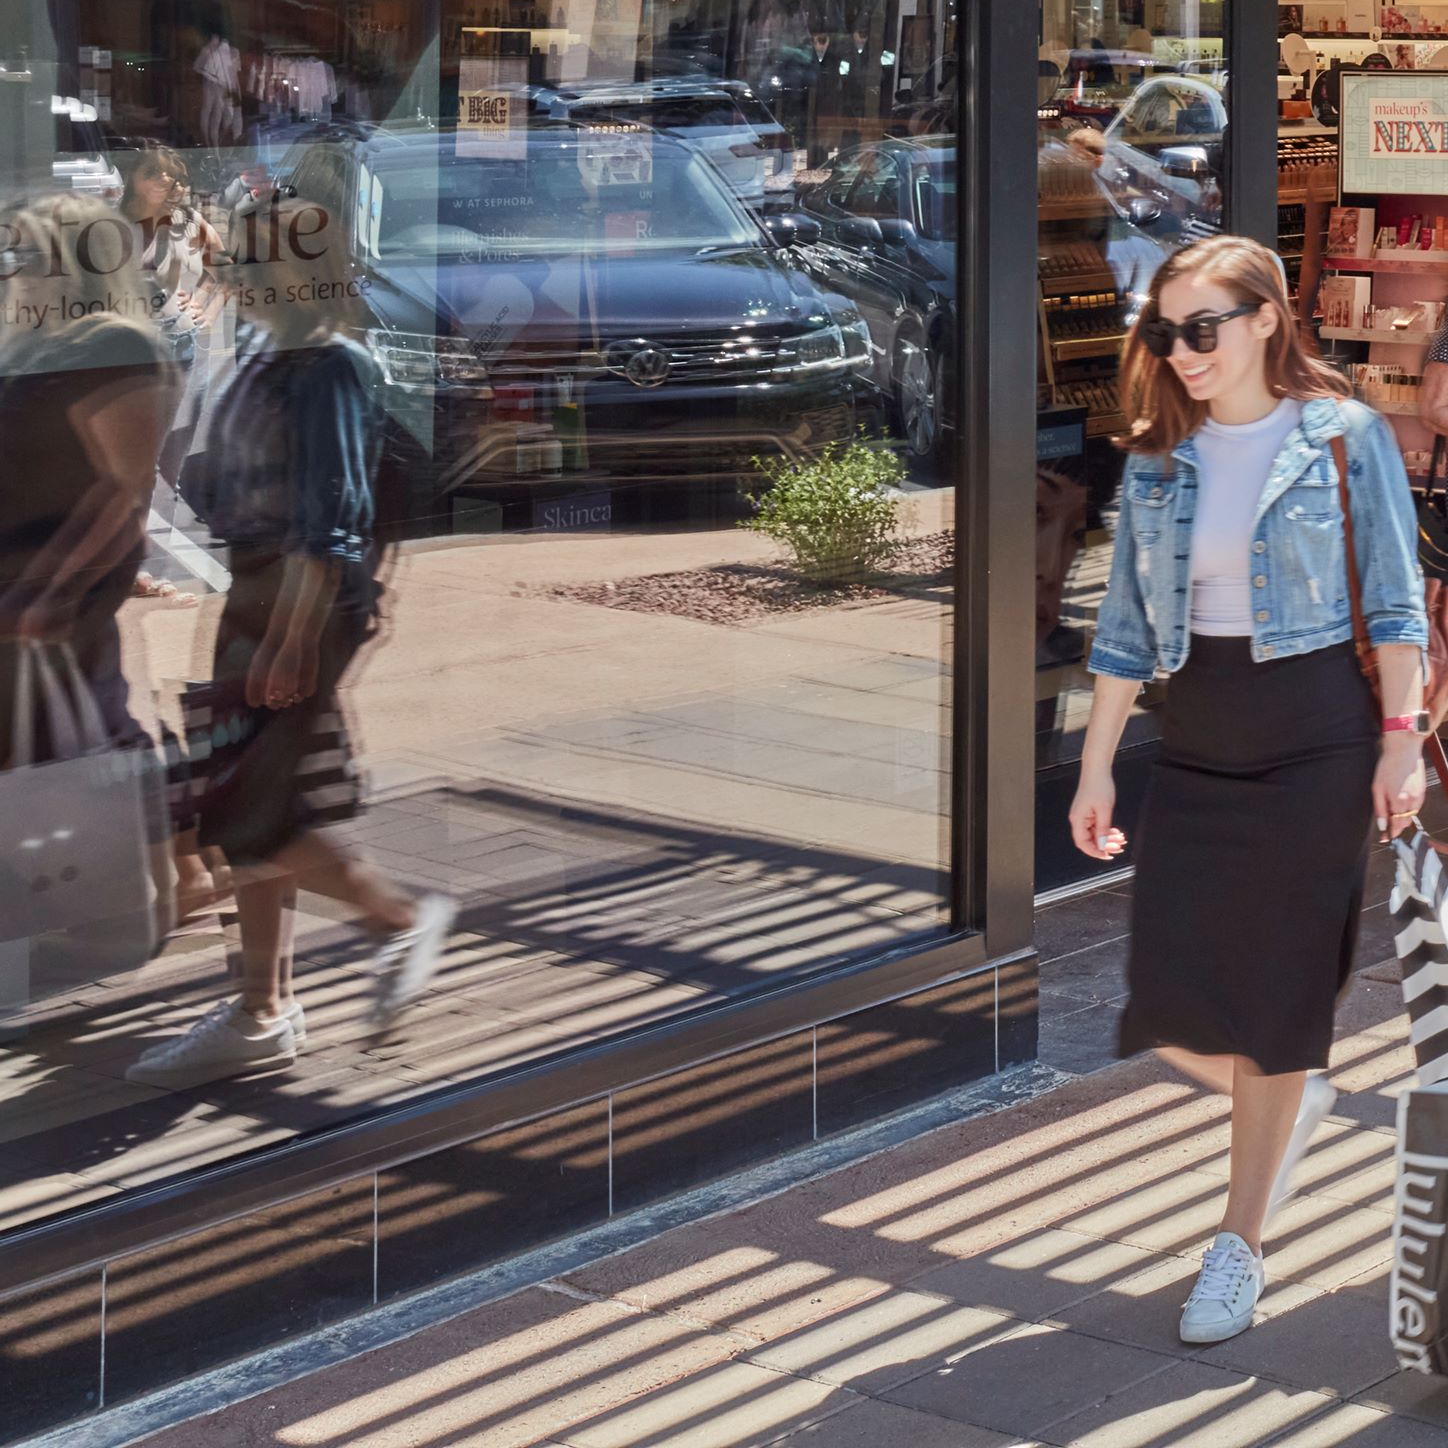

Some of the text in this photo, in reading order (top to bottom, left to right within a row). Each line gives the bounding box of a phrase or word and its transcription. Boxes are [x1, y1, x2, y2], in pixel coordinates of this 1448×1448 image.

[467, 95, 508, 125] BIG
[1374, 101, 1429, 119] makeup's
[484, 195, 535, 208] SEPHORA
[239, 285, 255, 308] is
[264, 290, 278, 306] a
[286, 277, 372, 303] science
